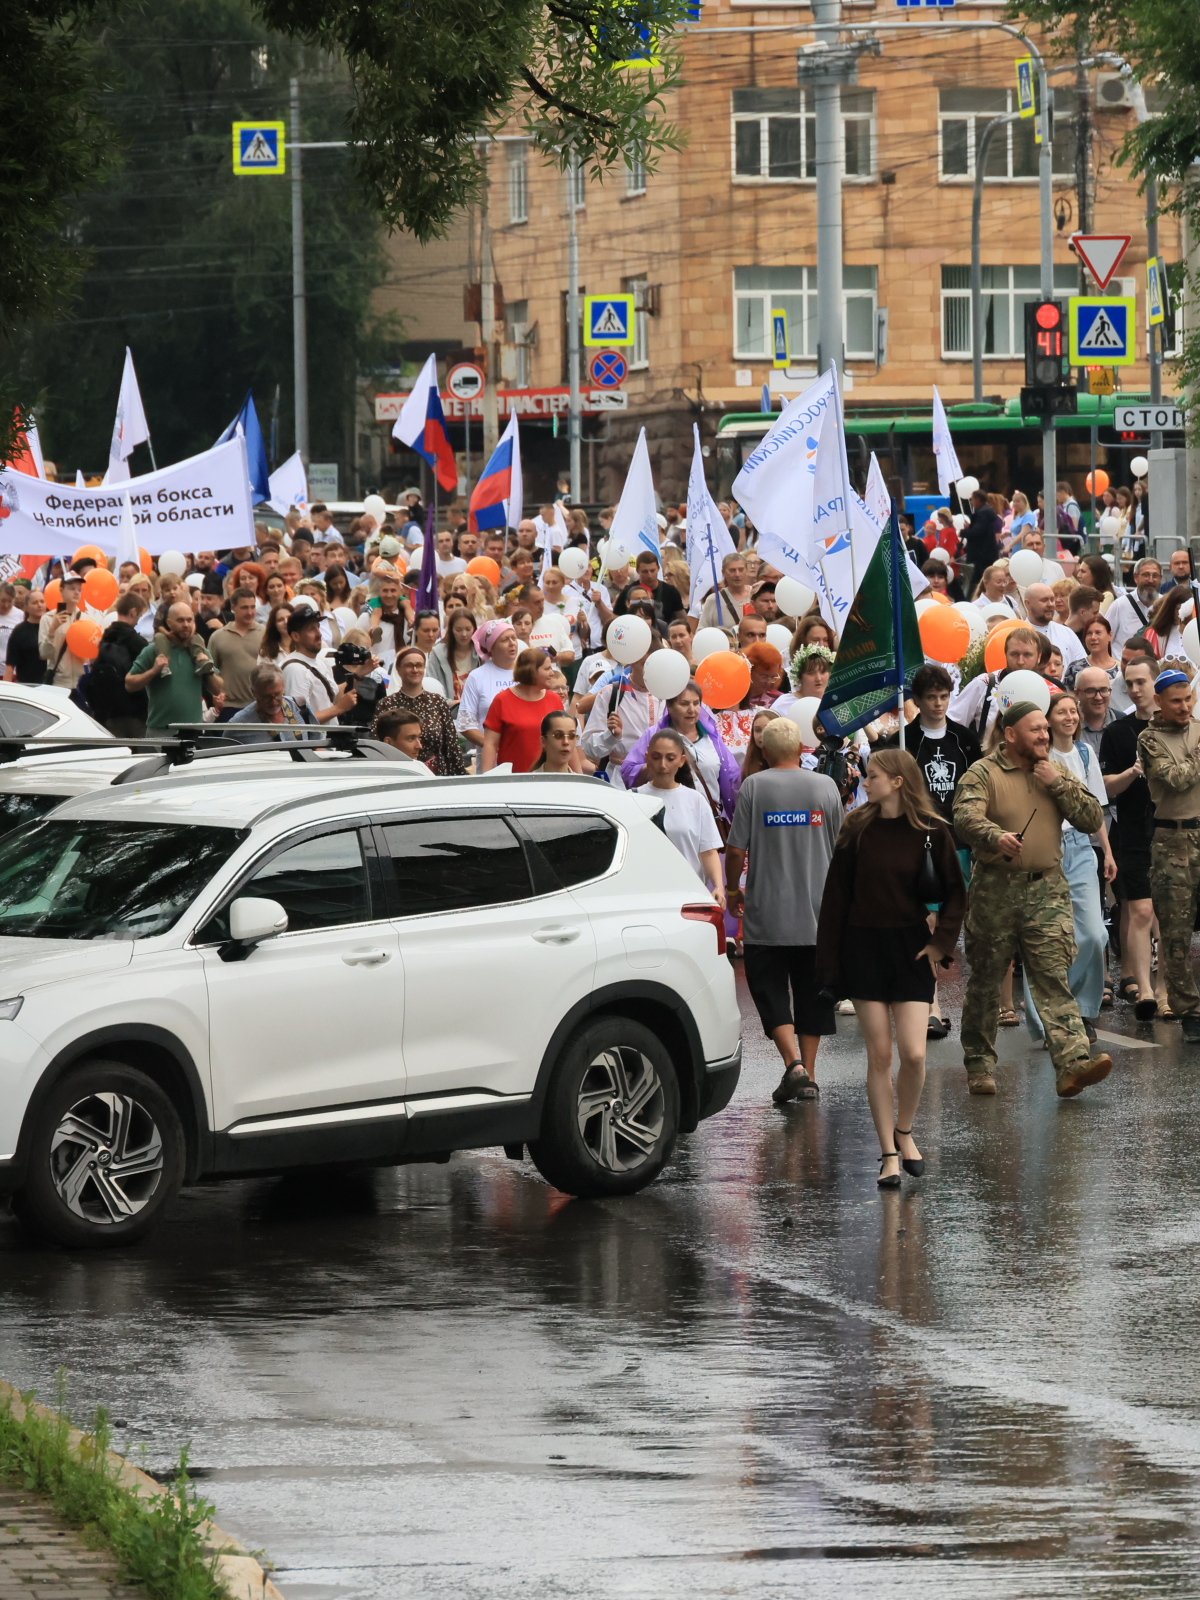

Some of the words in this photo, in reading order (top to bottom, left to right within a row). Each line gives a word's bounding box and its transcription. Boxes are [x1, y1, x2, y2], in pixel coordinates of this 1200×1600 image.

[1037, 331, 1061, 356] 41
[157, 486, 213, 504] бокса
[156, 503, 234, 523] области
[767, 814, 806, 824] РОССИЯ
[811, 814, 822, 823] 24
